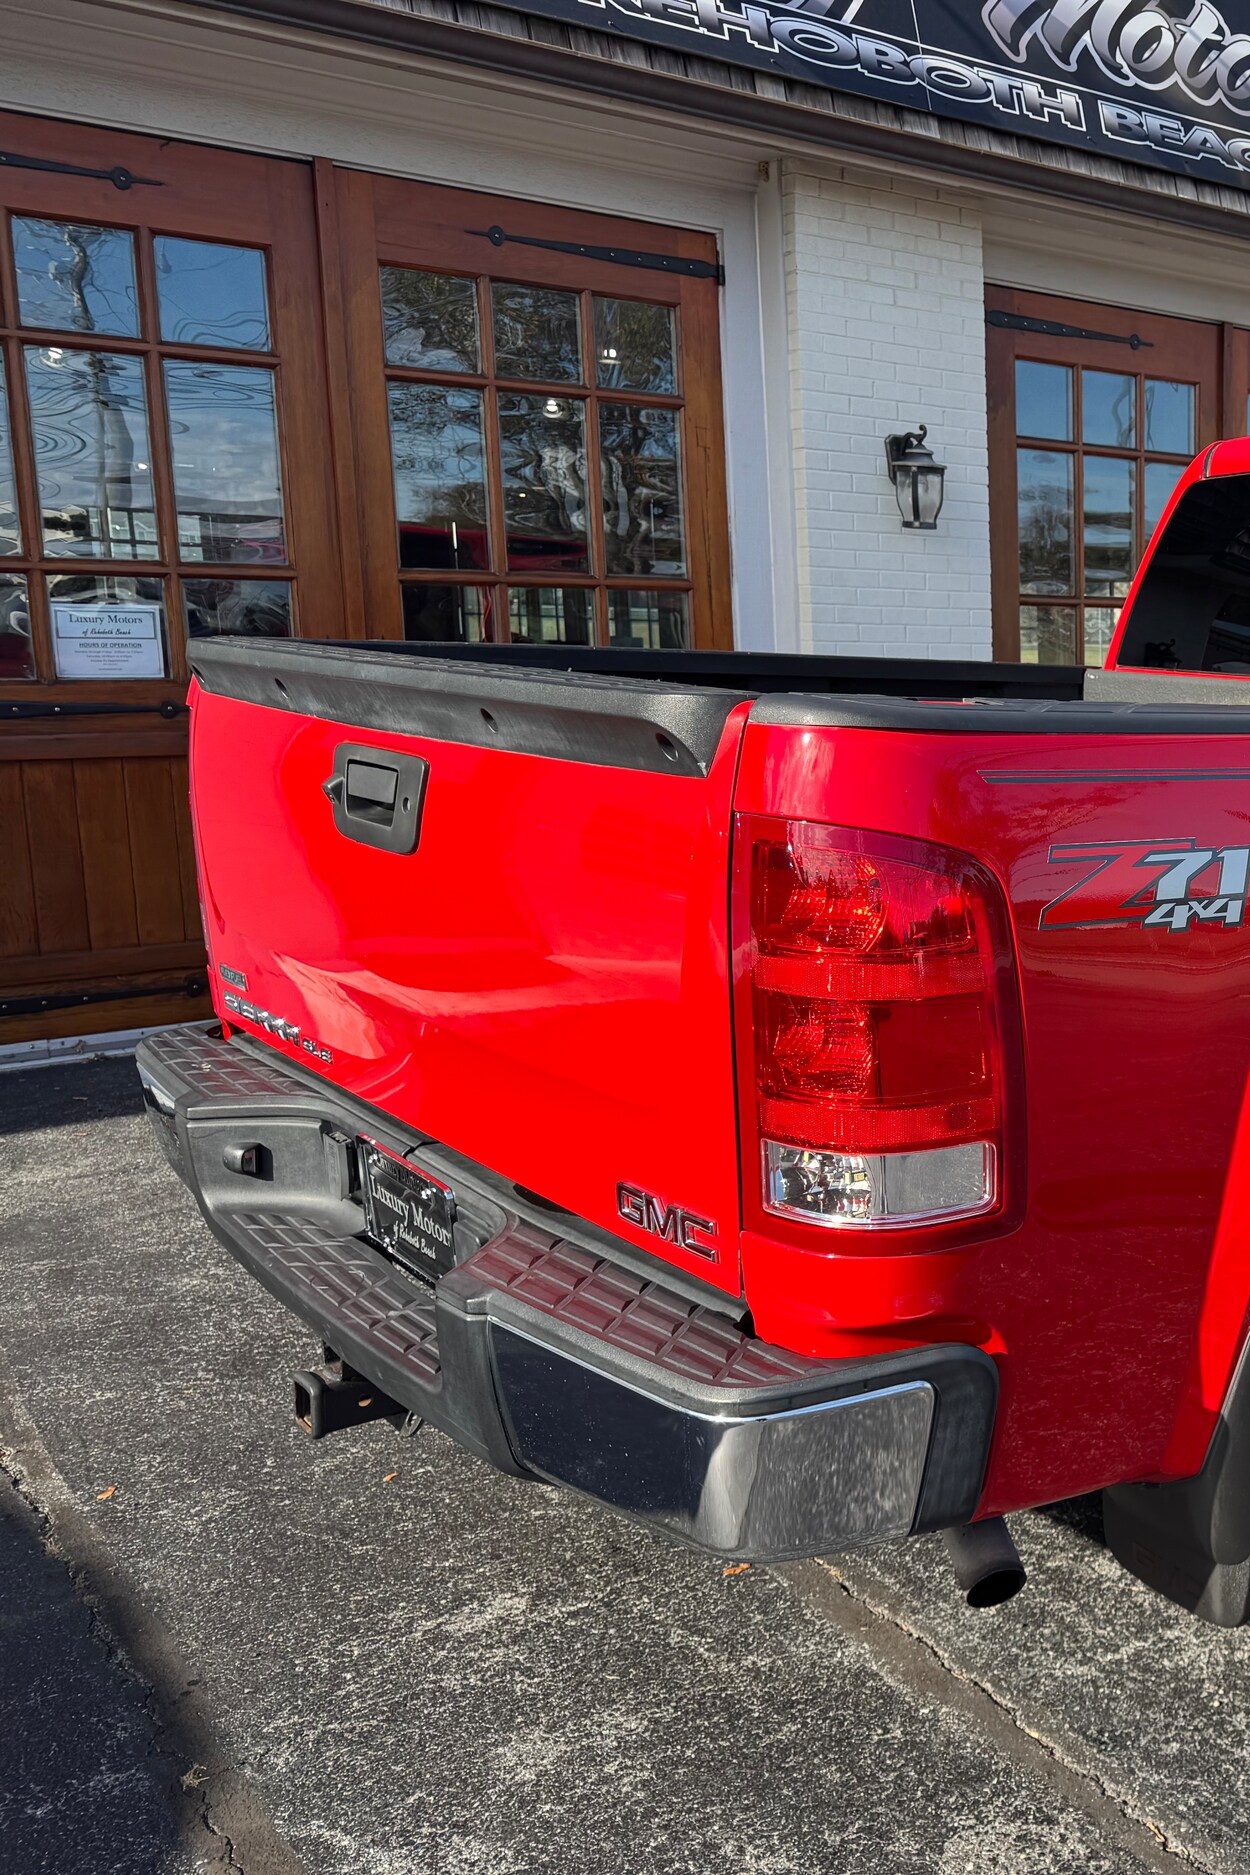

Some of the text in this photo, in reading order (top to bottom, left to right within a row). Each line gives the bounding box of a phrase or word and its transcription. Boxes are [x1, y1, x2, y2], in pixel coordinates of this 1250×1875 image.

[69, 613, 143, 625] Luxury Motors
[369, 1174, 410, 1227] Luxury
[616, 1181, 720, 1265] GMC
